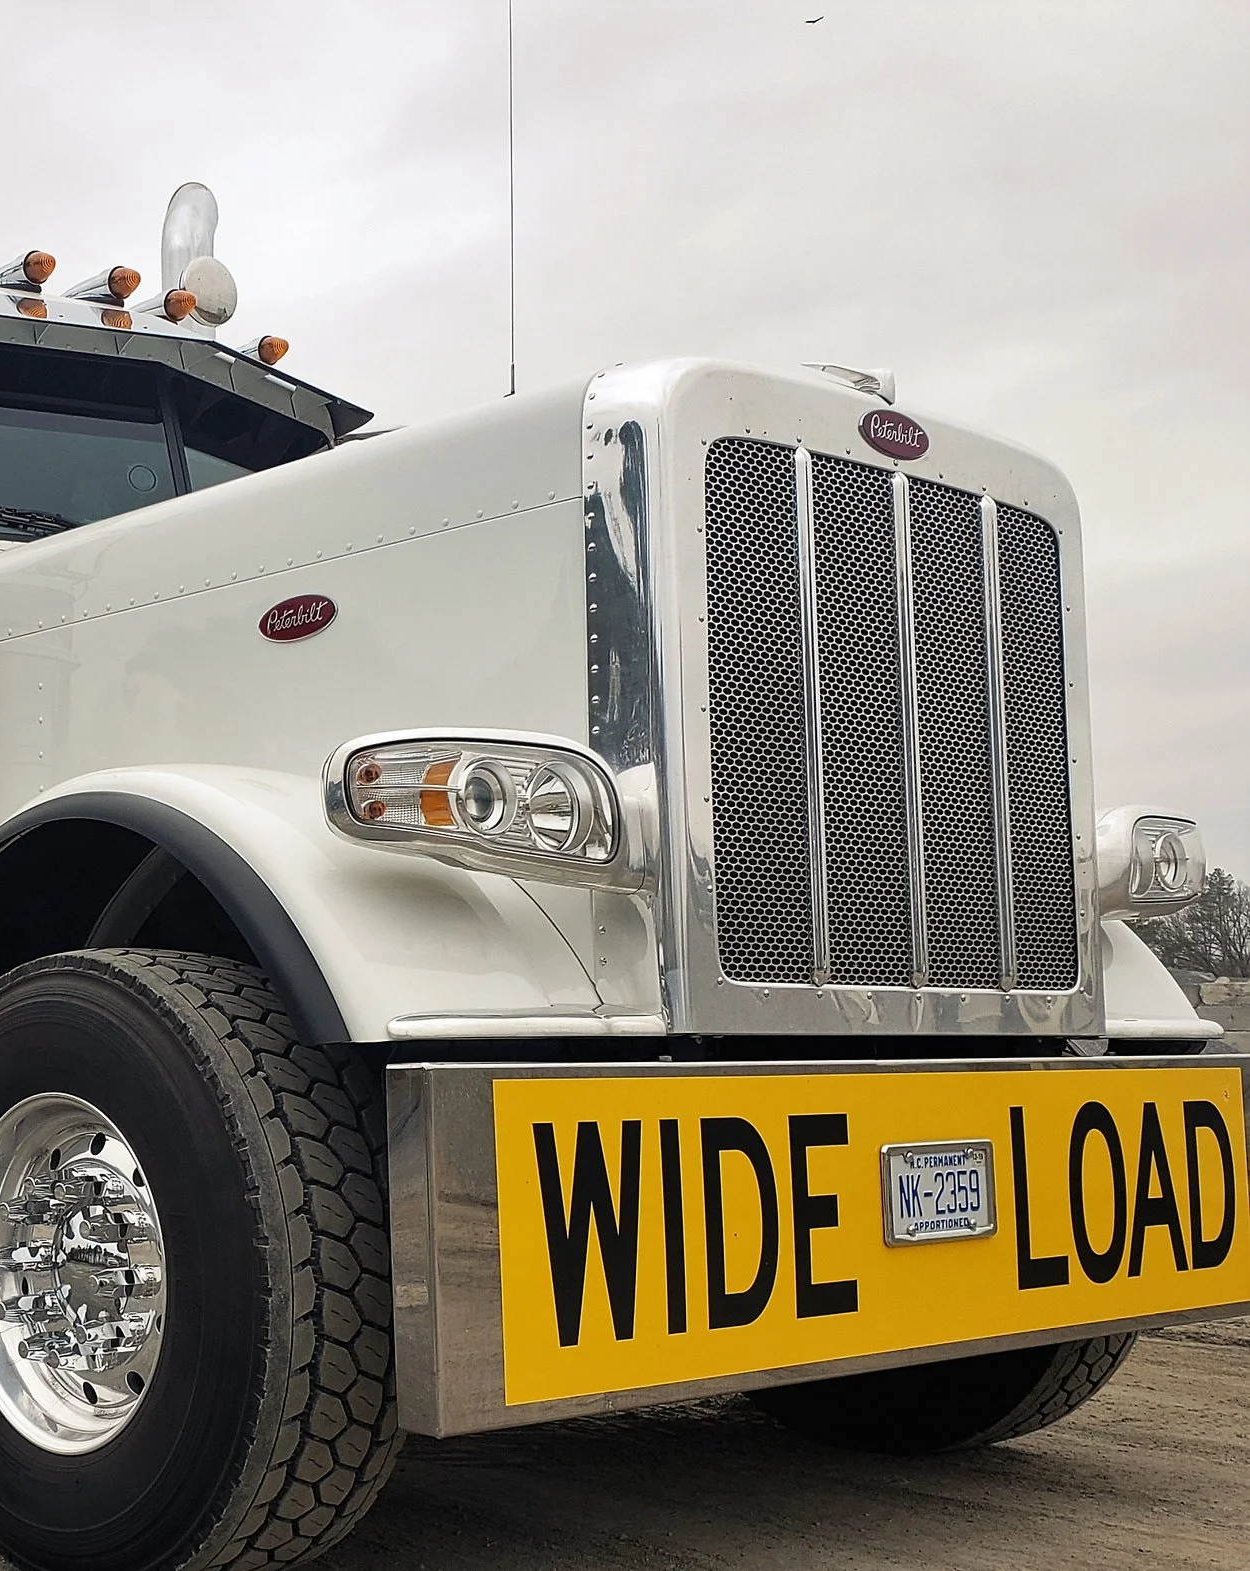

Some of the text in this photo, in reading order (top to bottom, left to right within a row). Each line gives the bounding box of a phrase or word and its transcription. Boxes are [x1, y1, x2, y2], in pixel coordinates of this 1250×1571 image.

[870, 414, 924, 448] Peterbilt
[266, 601, 328, 635] Peterbilt
[924, 1153, 967, 1168] PERMANENT
[899, 1169, 981, 1218] NK-2359
[532, 1100, 1235, 1348] WIDE LOAD
[914, 1217, 971, 1231] APPORTIONED
